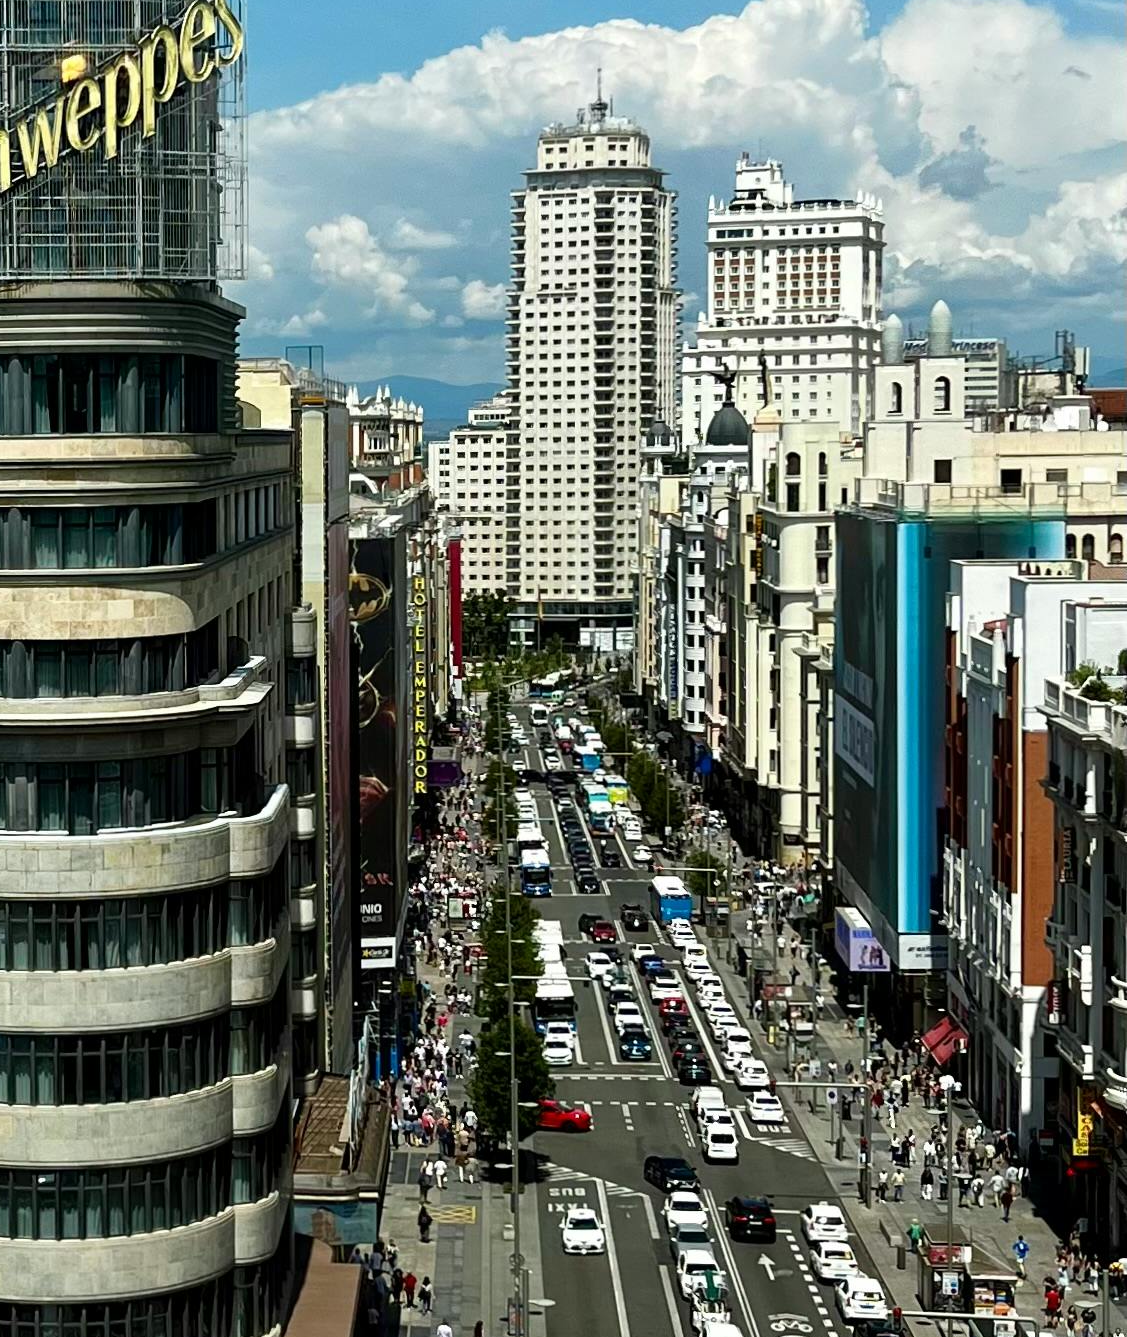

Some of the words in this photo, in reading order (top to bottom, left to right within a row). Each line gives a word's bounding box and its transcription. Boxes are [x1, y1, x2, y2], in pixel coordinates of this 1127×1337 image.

[413, 577, 427, 653] HOTEL
[413, 662, 428, 794] EMPERADOR
[549, 1188, 586, 1197] BUS
